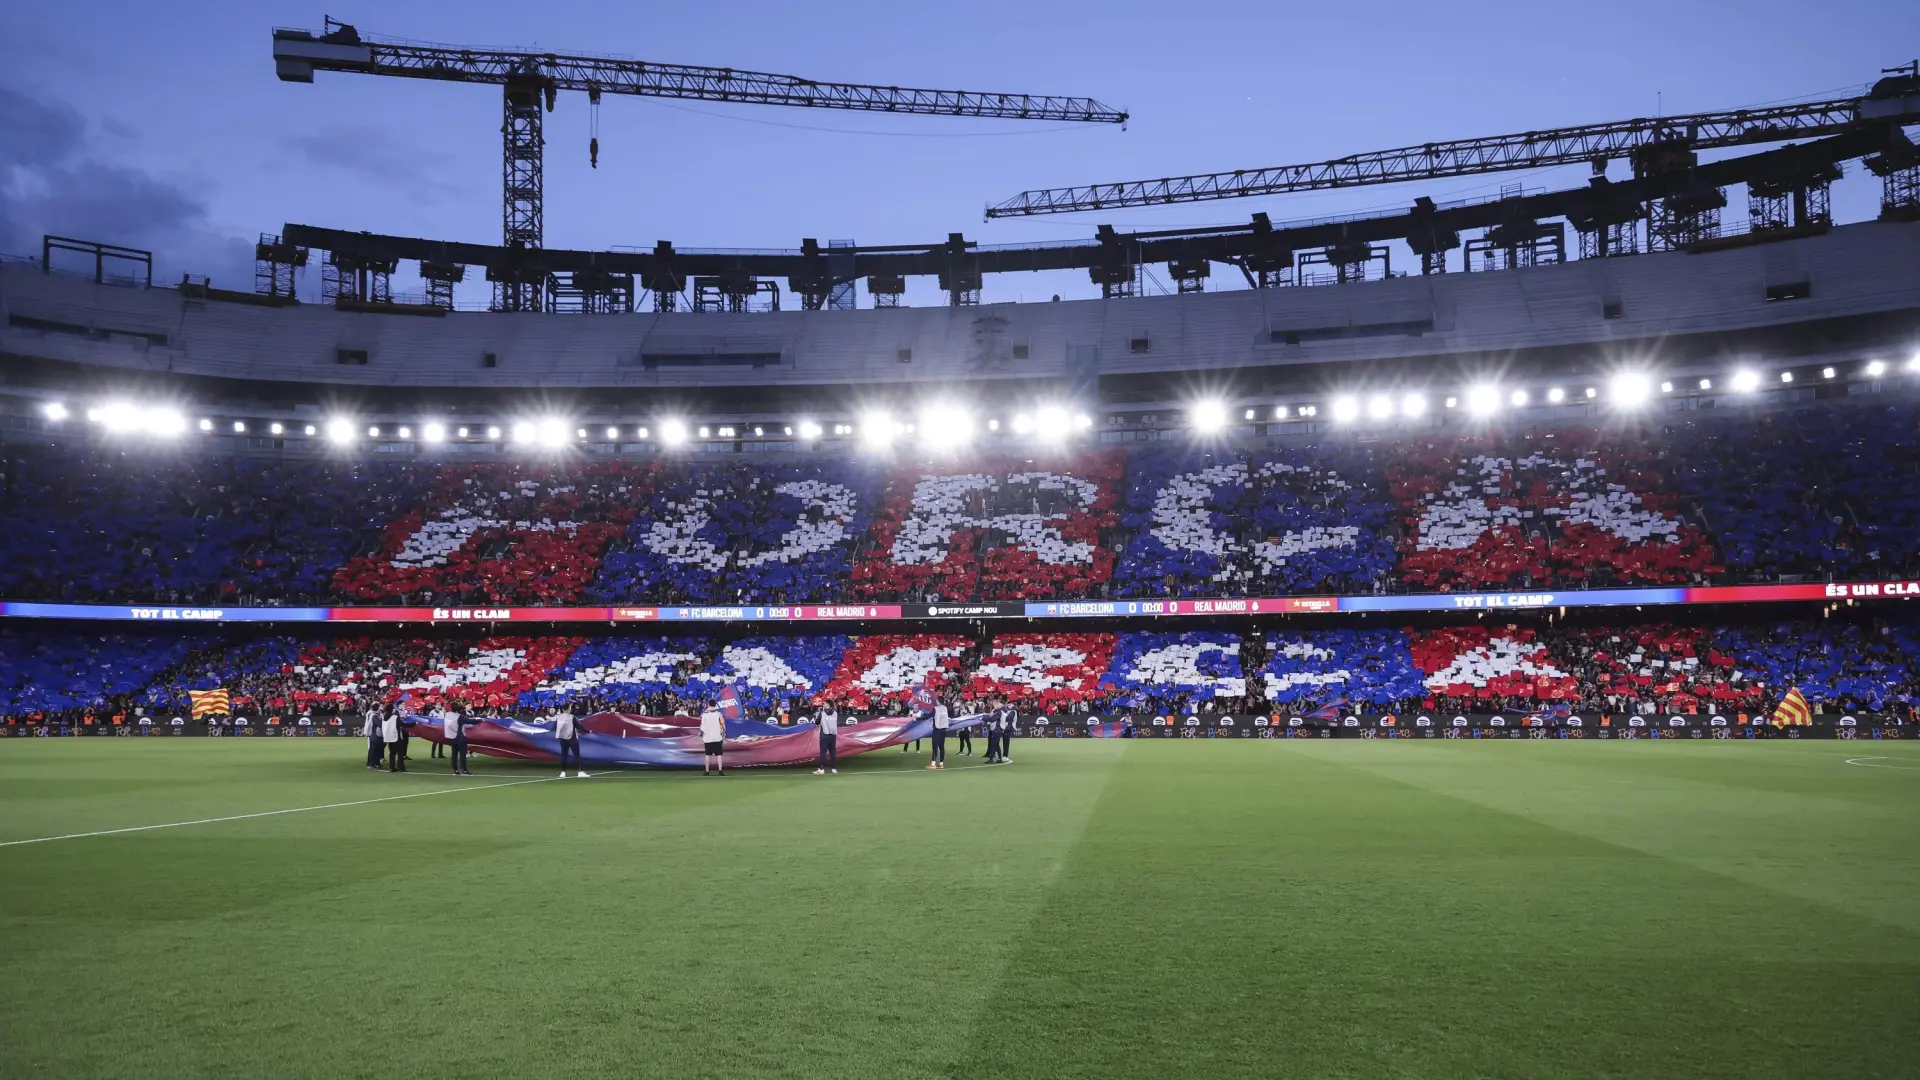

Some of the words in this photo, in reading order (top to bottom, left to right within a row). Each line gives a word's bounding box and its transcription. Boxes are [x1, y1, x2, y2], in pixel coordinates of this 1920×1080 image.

[1826, 584, 1848, 597] ÉS
[1852, 584, 1879, 596] UN
[1883, 583, 1920, 595] CLA
[1194, 602, 1213, 612] REAL
[1215, 600, 1247, 611] MADRID
[1454, 596, 1484, 608] TOT
[1486, 596, 1505, 608] EL
[1507, 595, 1554, 608] CAMP
[131, 608, 159, 619] TOT
[163, 609, 180, 619] EL
[182, 609, 223, 620] CAMP
[432, 608, 450, 620] ÉS
[452, 609, 471, 620] UN
[473, 609, 511, 620] CLAM
[691, 608, 701, 618] FC
[702, 608, 744, 618] BARCELONA
[756, 607, 764, 618] 0
[769, 608, 790, 618] 00:00
[794, 607, 802, 618] 0
[817, 607, 834, 617] REAL
[836, 607, 865, 617] MADRID
[937, 607, 964, 616] SPOTIFY
[965, 607, 983, 616] CAMP
[984, 606, 998, 615] NOU
[1060, 604, 1069, 614] FC
[1071, 603, 1115, 614] BARCELONA
[1128, 602, 1137, 614] 0
[1142, 602, 1164, 613] 00:00
[1169, 602, 1178, 613] 0
